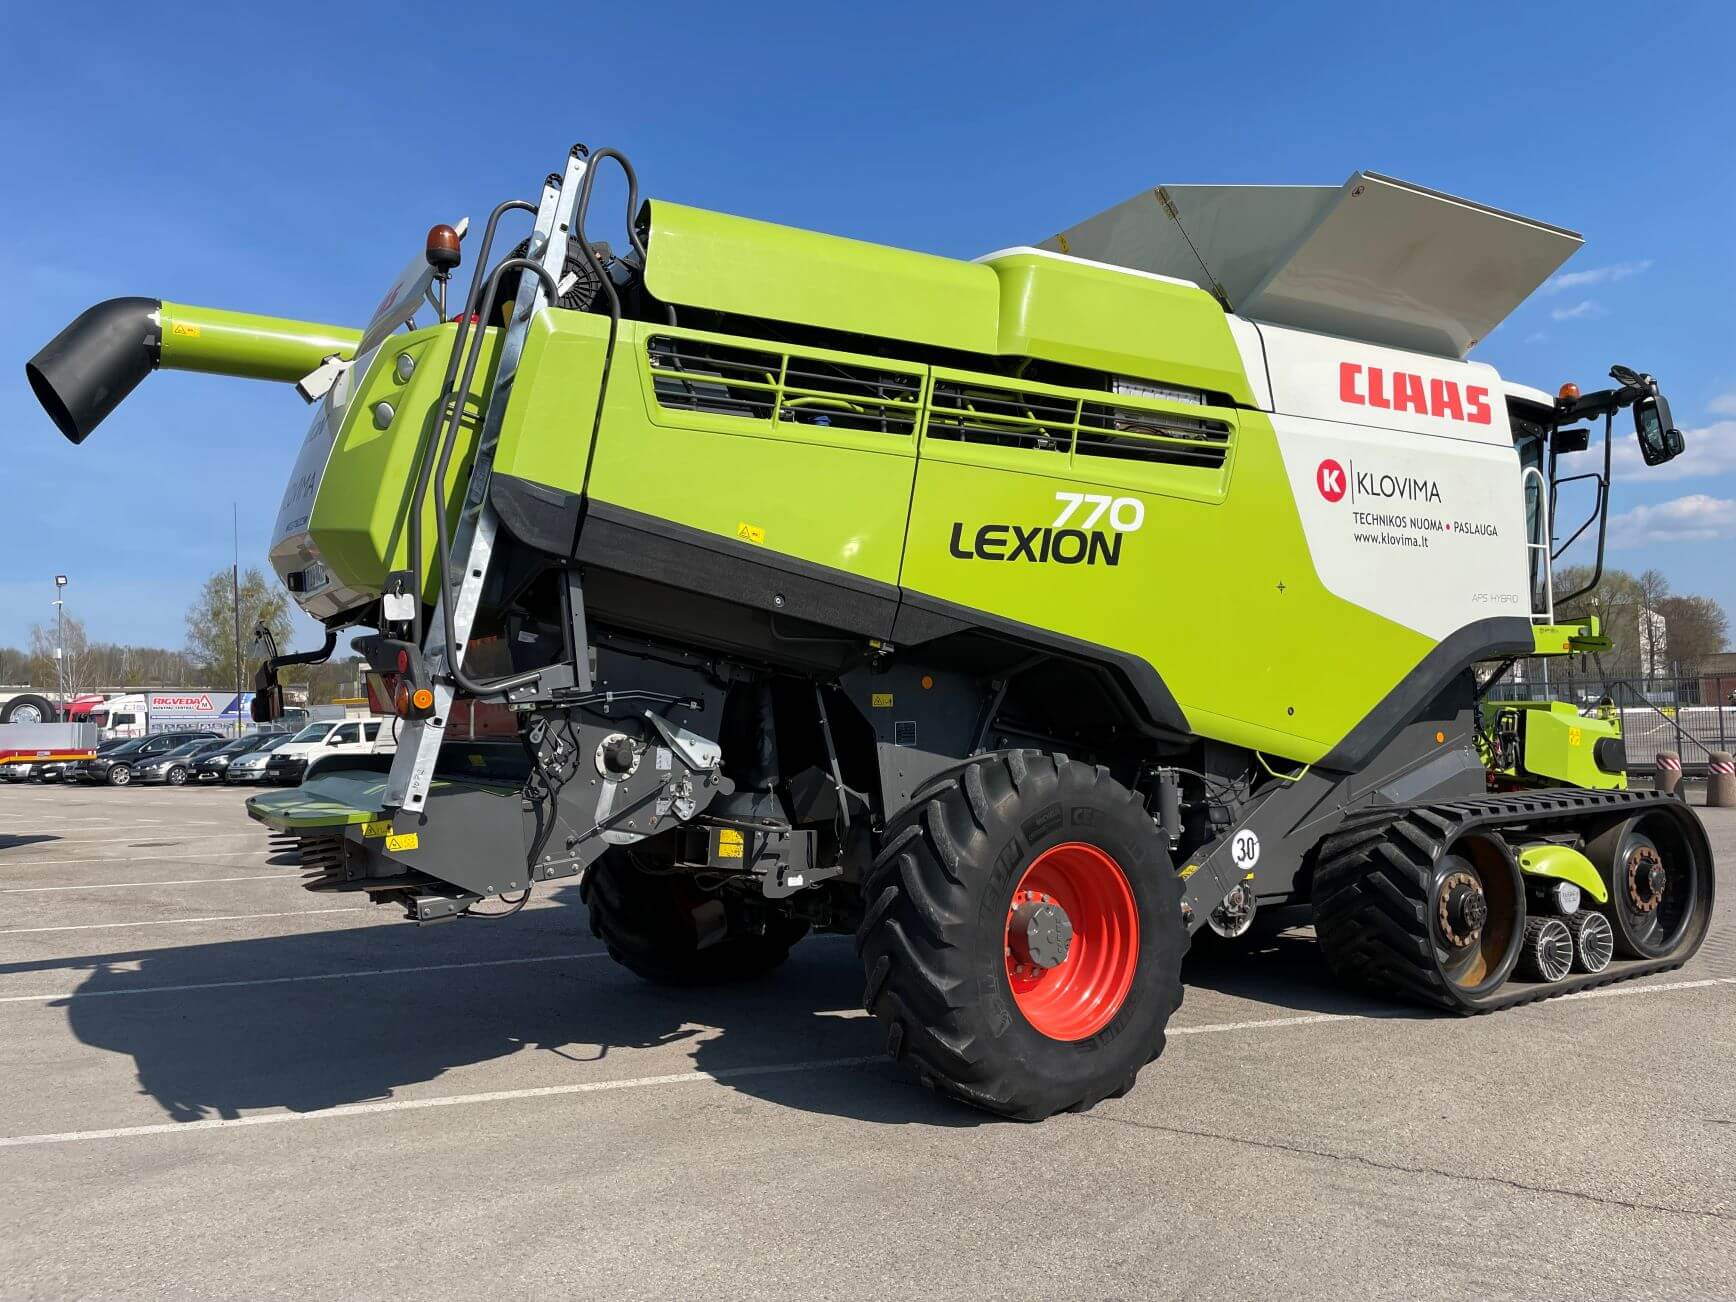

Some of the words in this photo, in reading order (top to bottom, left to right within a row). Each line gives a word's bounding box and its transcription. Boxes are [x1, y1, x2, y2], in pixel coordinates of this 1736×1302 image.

[1339, 362, 1492, 425] CLAAS
[1322, 468, 1341, 494] K
[1357, 471, 1442, 503] KLOVIMA
[1052, 491, 1145, 532] 770
[1353, 512, 1407, 528] TECHNIKOS
[1410, 517, 1444, 532] NUOMA
[1454, 521, 1498, 537] PASLAUGA
[949, 522, 1123, 566] LEXION
[1354, 532, 1429, 548] www.klovima.lt
[1472, 593, 1488, 603] APS
[1490, 594, 1519, 604] HYBRID
[153, 697, 200, 705] RIGVEDA
[1237, 837, 1255, 862] 30
